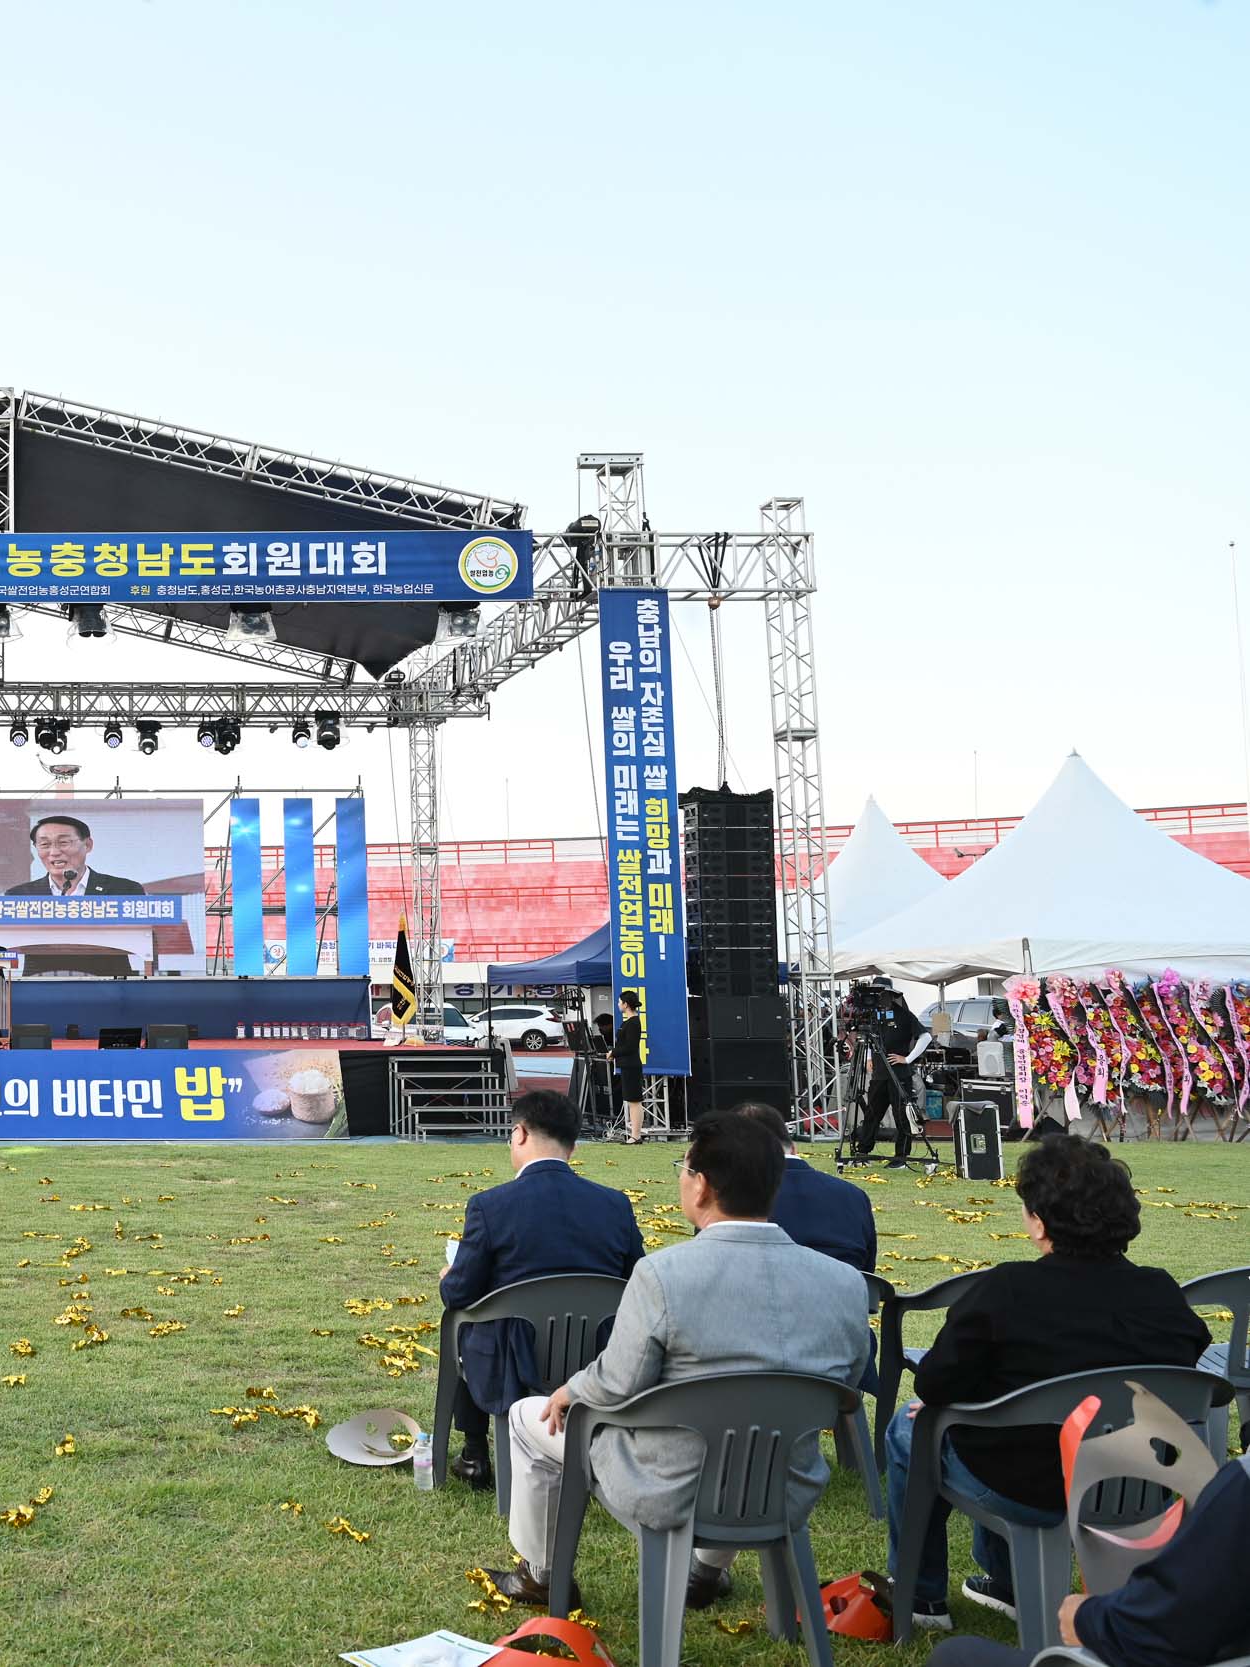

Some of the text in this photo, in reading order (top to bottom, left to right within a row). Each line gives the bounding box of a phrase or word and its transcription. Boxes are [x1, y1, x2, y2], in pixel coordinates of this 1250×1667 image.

[130, 585, 151, 596] 후원
[373, 583, 434, 595] 한국농업신문
[608, 641, 634, 692] 우리
[611, 706, 637, 757] 쌀의
[613, 764, 640, 841] 미래는
[636, 598, 675, 960] 충남의 자존심 쌀 희망과 미래!
[121, 900, 175, 919] 회원대회
[616, 849, 646, 978] 쌀전업농이
[52, 1078, 164, 1119] 비타민
[174, 1066, 243, 1122] 밥”
